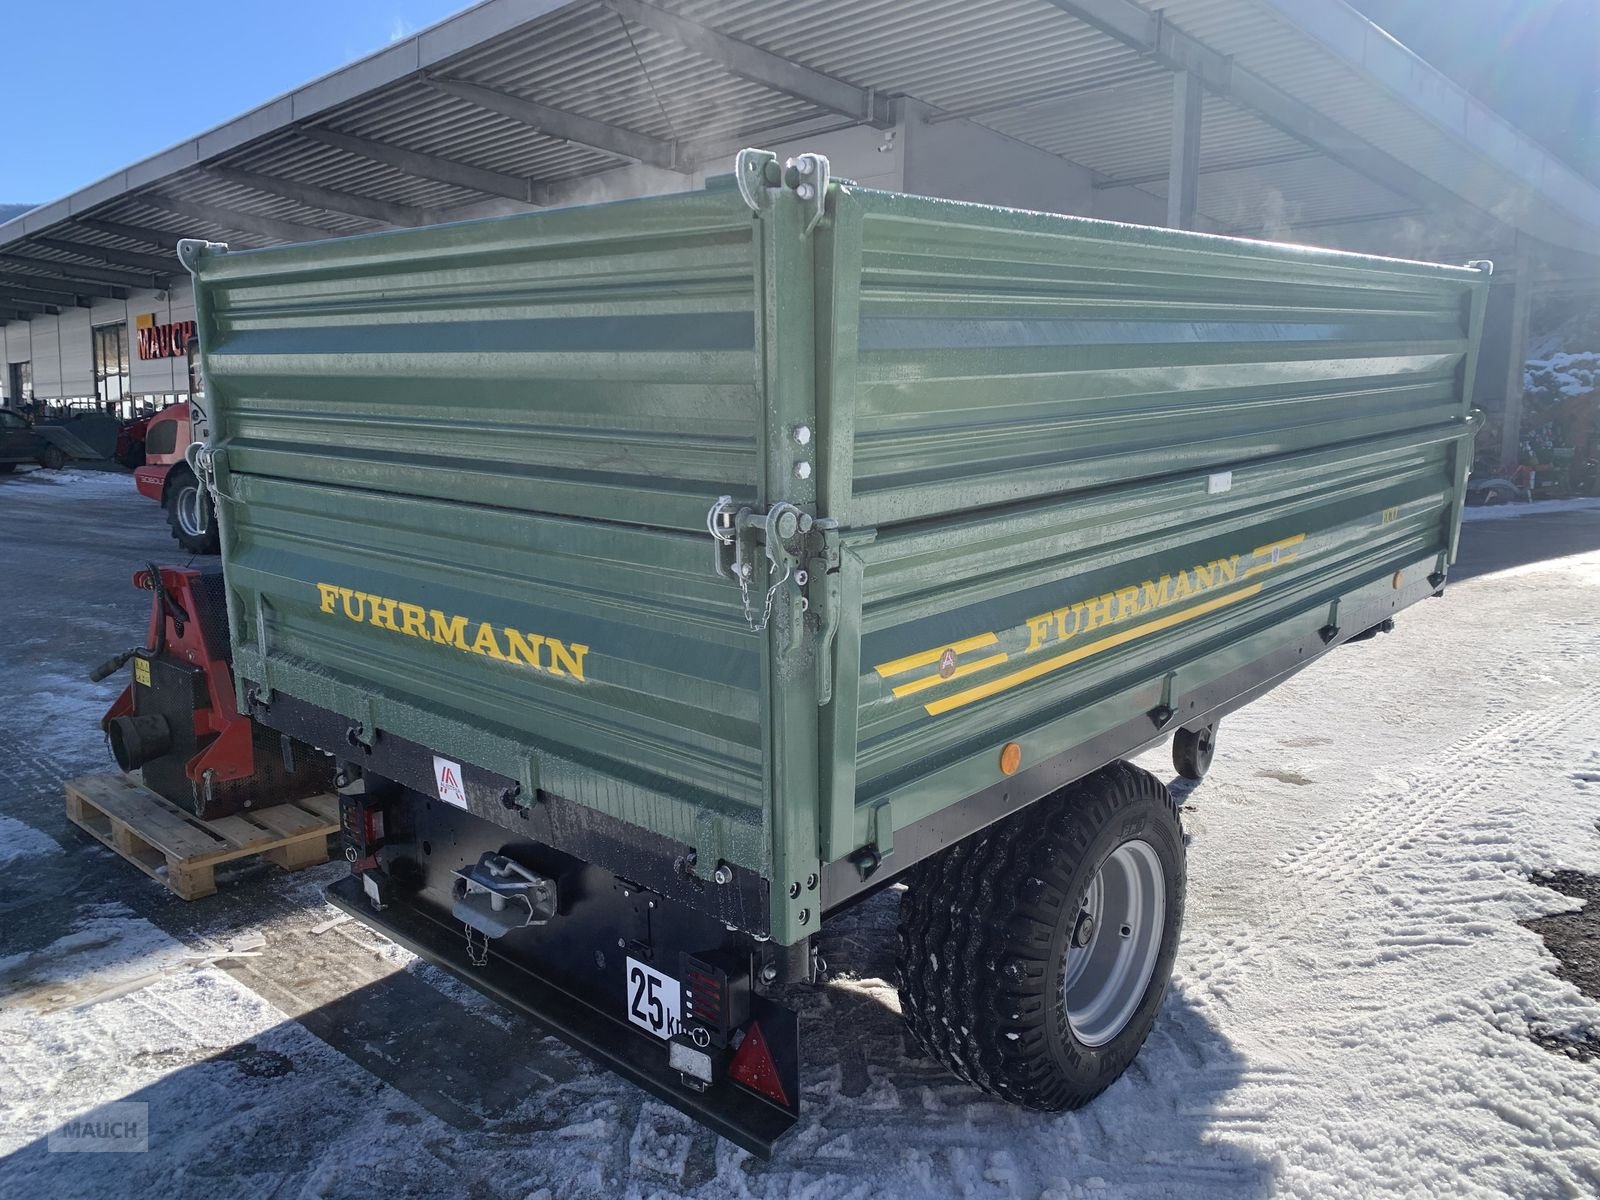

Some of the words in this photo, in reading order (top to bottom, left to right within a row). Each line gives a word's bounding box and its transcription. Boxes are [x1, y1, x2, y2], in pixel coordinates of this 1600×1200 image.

[317, 582, 589, 682] FUHRMANN
[1025, 555, 1239, 653] FUHRMANN
[631, 967, 663, 1032] 25
